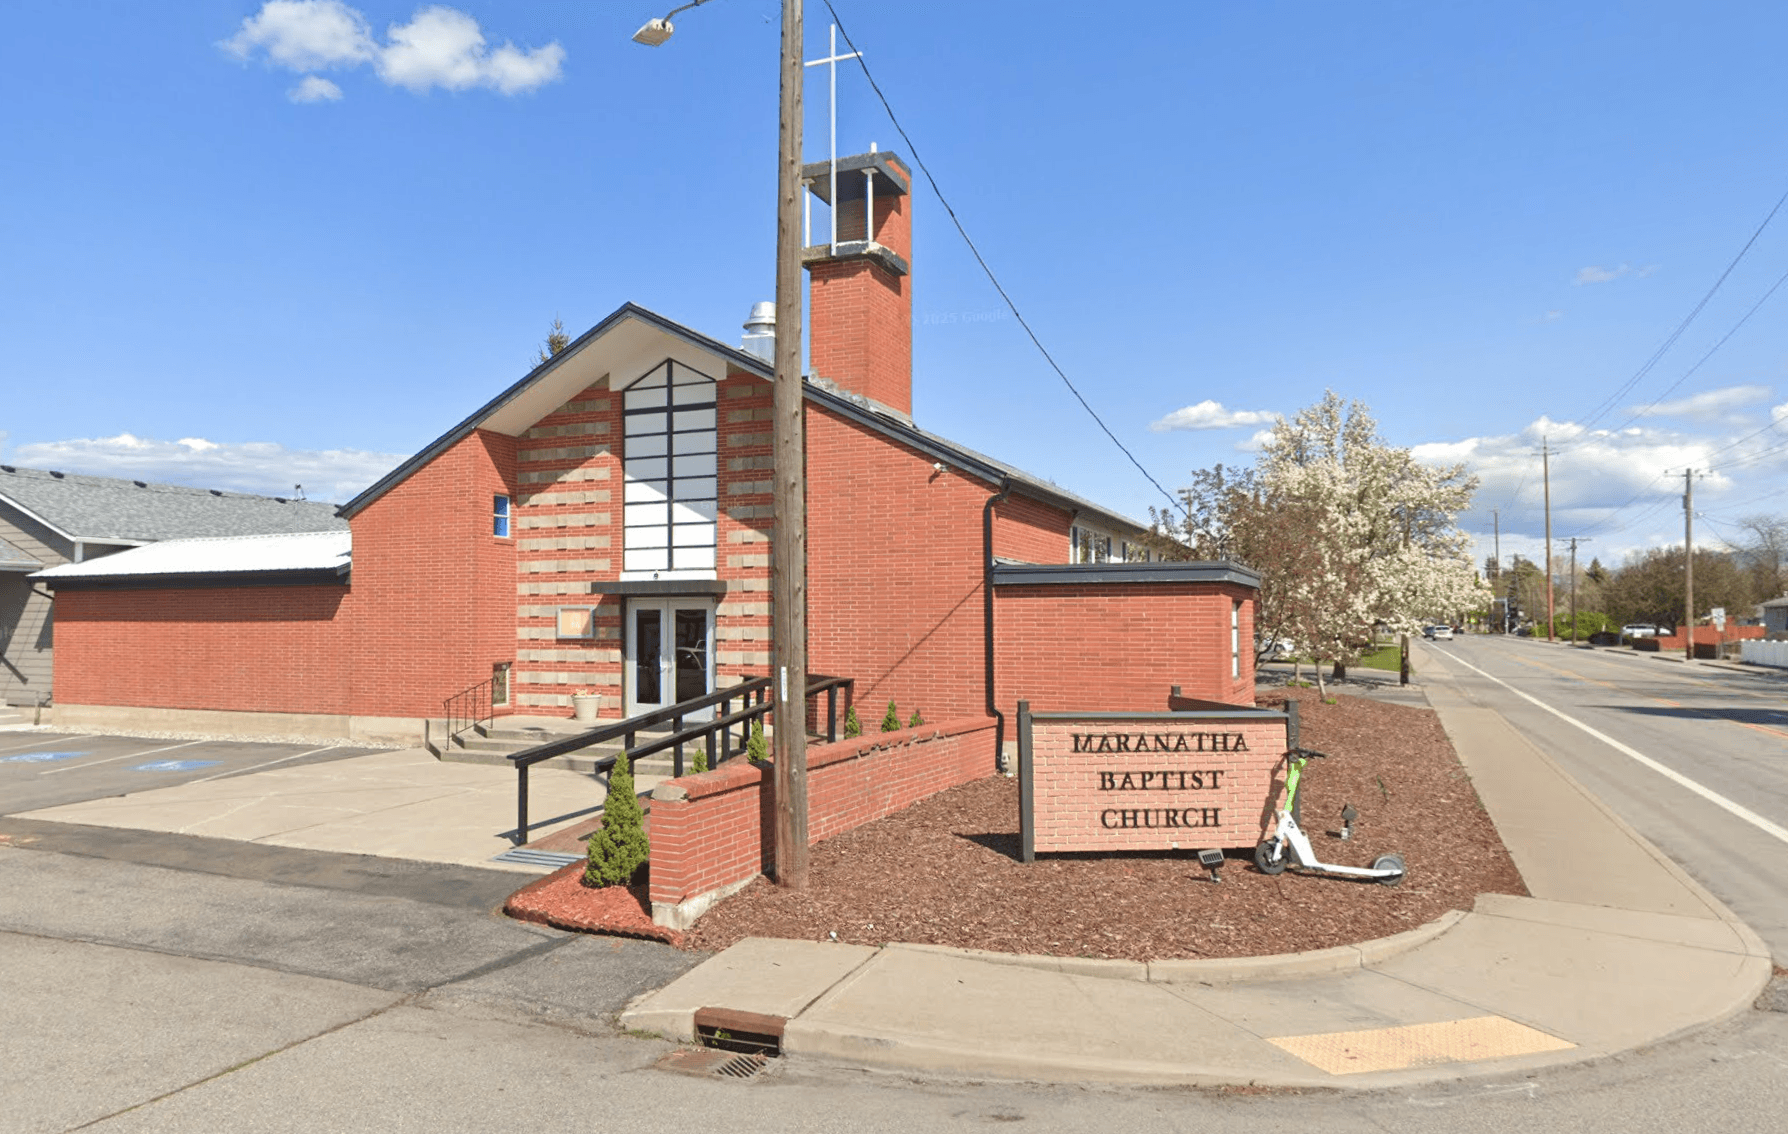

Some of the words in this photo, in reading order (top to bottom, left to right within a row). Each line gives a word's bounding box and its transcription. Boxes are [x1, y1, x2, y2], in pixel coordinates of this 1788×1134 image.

[1072, 732, 1250, 754] MARANATHA
[1098, 770, 1225, 791] BAPTIST
[1100, 808, 1222, 829] CHURCH
